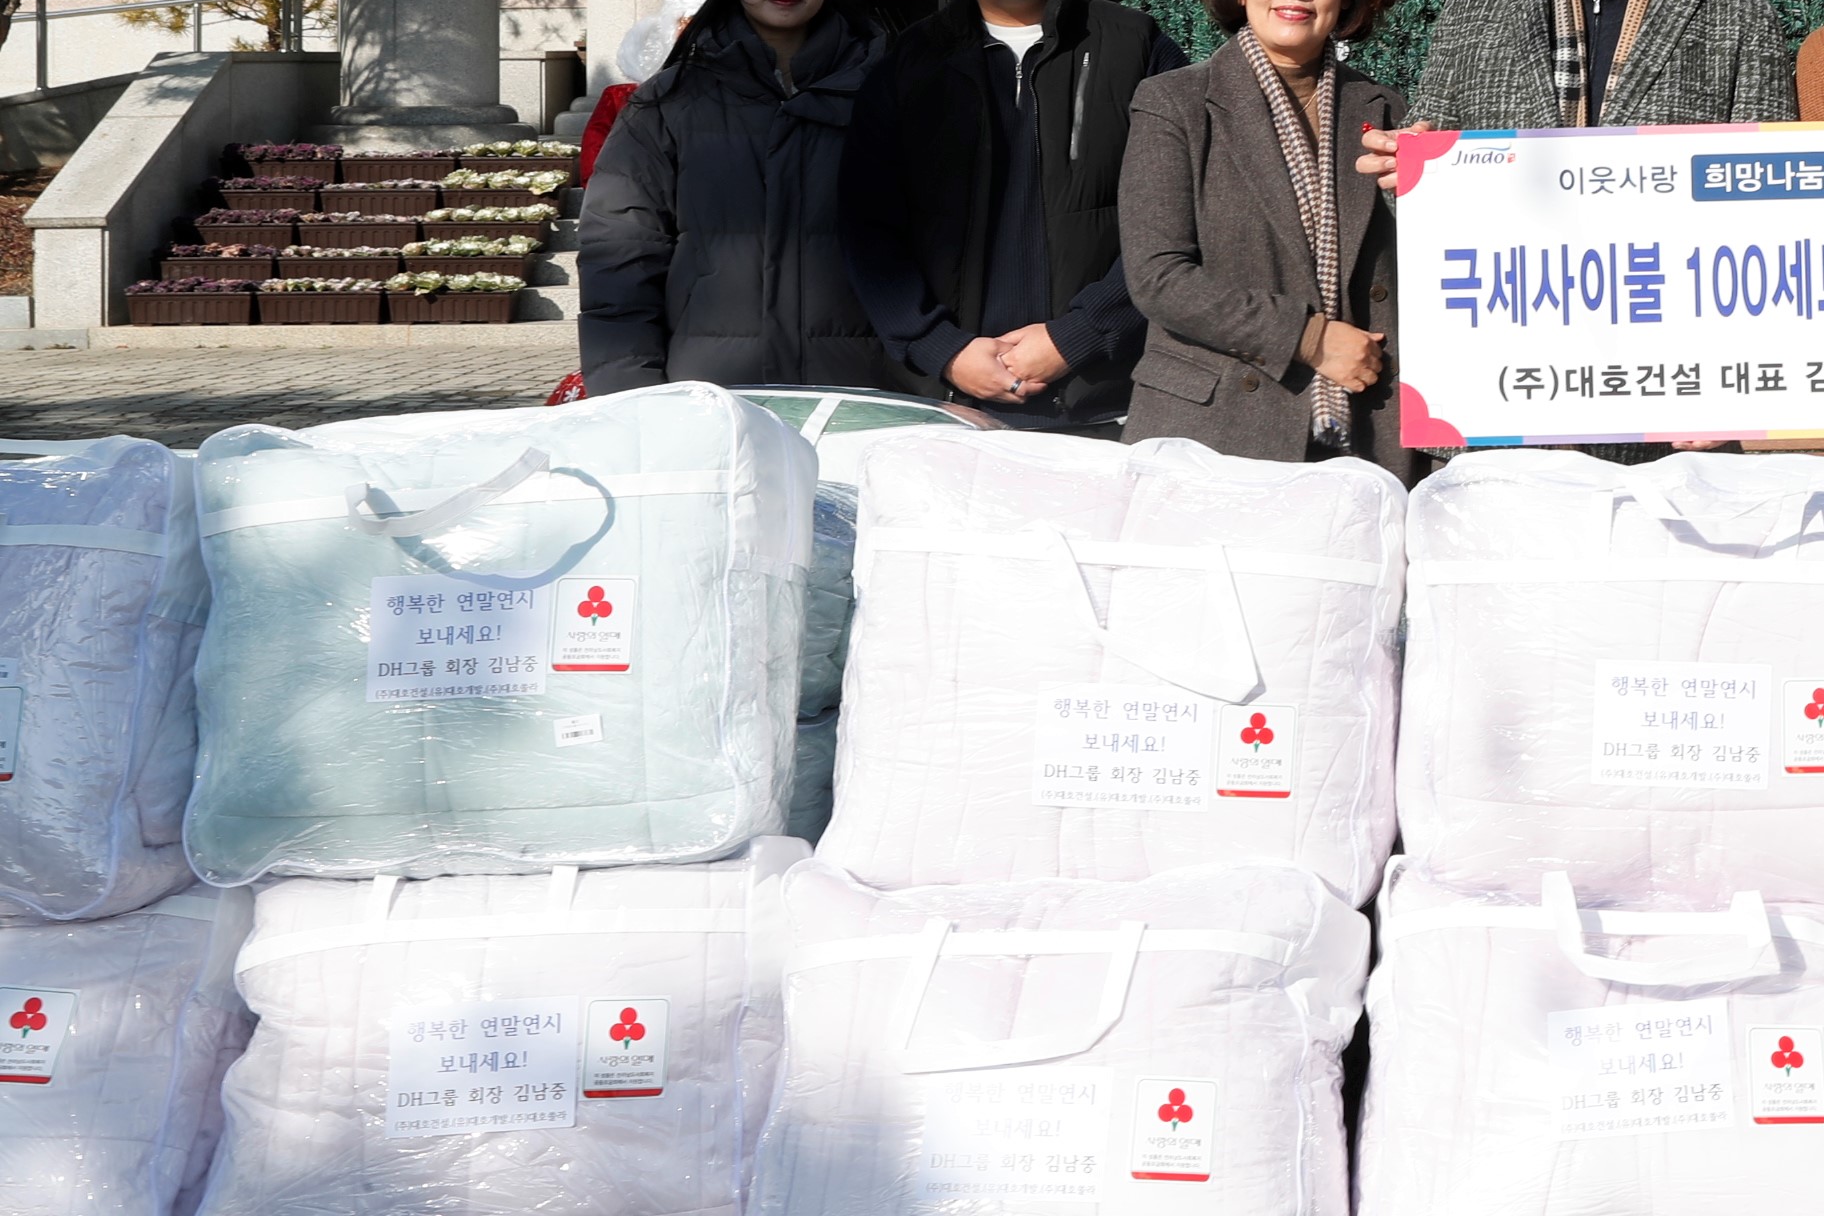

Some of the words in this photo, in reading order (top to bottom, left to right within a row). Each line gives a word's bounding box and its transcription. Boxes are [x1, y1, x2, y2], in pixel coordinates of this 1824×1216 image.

[1451, 150, 1505, 166] Jindo
[1558, 163, 1679, 196] 이웃사랑
[1440, 240, 1666, 329] 극세사이불
[1498, 361, 1703, 403] (주)대호건설
[1720, 362, 1789, 396] 대표
[386, 591, 446, 616] 행복한
[457, 588, 534, 612] 연말연시
[416, 624, 502, 646] 보내세요!
[378, 661, 436, 677] DH그룹
[445, 657, 478, 676] 회장
[488, 655, 539, 674] 김남중
[1611, 675, 1669, 696] 행복한
[1681, 678, 1757, 699] 연말연시
[1054, 697, 1111, 719] 행복한
[1123, 701, 1198, 723] 연말연시
[1641, 710, 1725, 730] 보내세요!
[1082, 733, 1166, 753] 보내세요!
[1603, 742, 1661, 760] DH그룹
[1671, 743, 1702, 762] 회장
[1712, 743, 1761, 764] 김남중
[1044, 763, 1101, 782] DH그룹
[1110, 765, 1143, 784] 회장
[1152, 766, 1201, 787] 김남중
[407, 1018, 468, 1043] 행복한
[480, 1012, 562, 1038] 연말연시
[1564, 1021, 1624, 1046] 행복한
[1635, 1014, 1713, 1040] 연말연시
[436, 1050, 528, 1073] 보내세요!
[1598, 1052, 1684, 1076] 보내세요!
[397, 1088, 459, 1109] DH그룹
[469, 1085, 504, 1106] 회장
[513, 1082, 567, 1103] 김남중
[1631, 1088, 1663, 1107] 회장
[1674, 1083, 1724, 1104] 김남중
